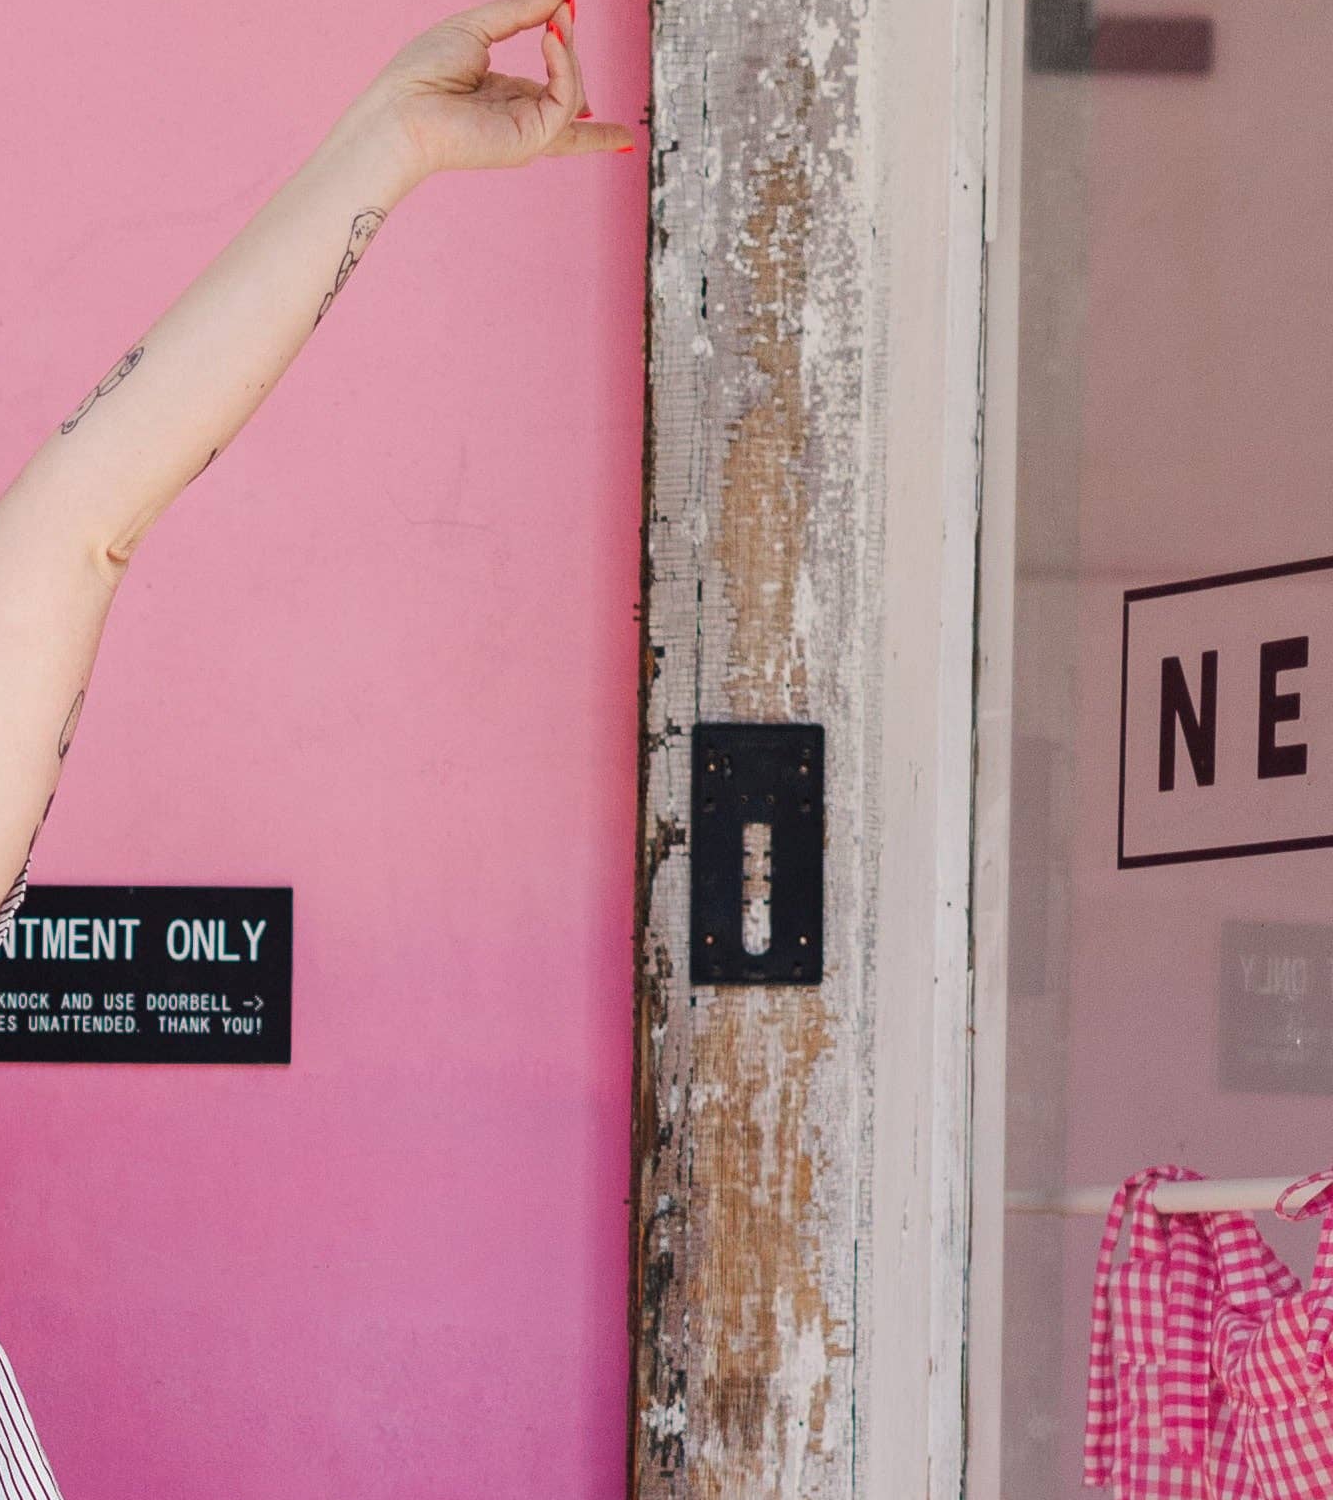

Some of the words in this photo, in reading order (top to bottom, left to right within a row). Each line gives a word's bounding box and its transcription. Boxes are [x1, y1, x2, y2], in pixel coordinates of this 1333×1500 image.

[166, 919, 266, 962] ONLY
[60, 993, 93, 1011] AND
[103, 993, 135, 1011] USE
[146, 994, 232, 1012] DOORBELL
[28, 1015, 140, 1033] UNATTENDED.
[158, 1016, 210, 1034] THANK
[221, 1017, 262, 1035] YOU!
